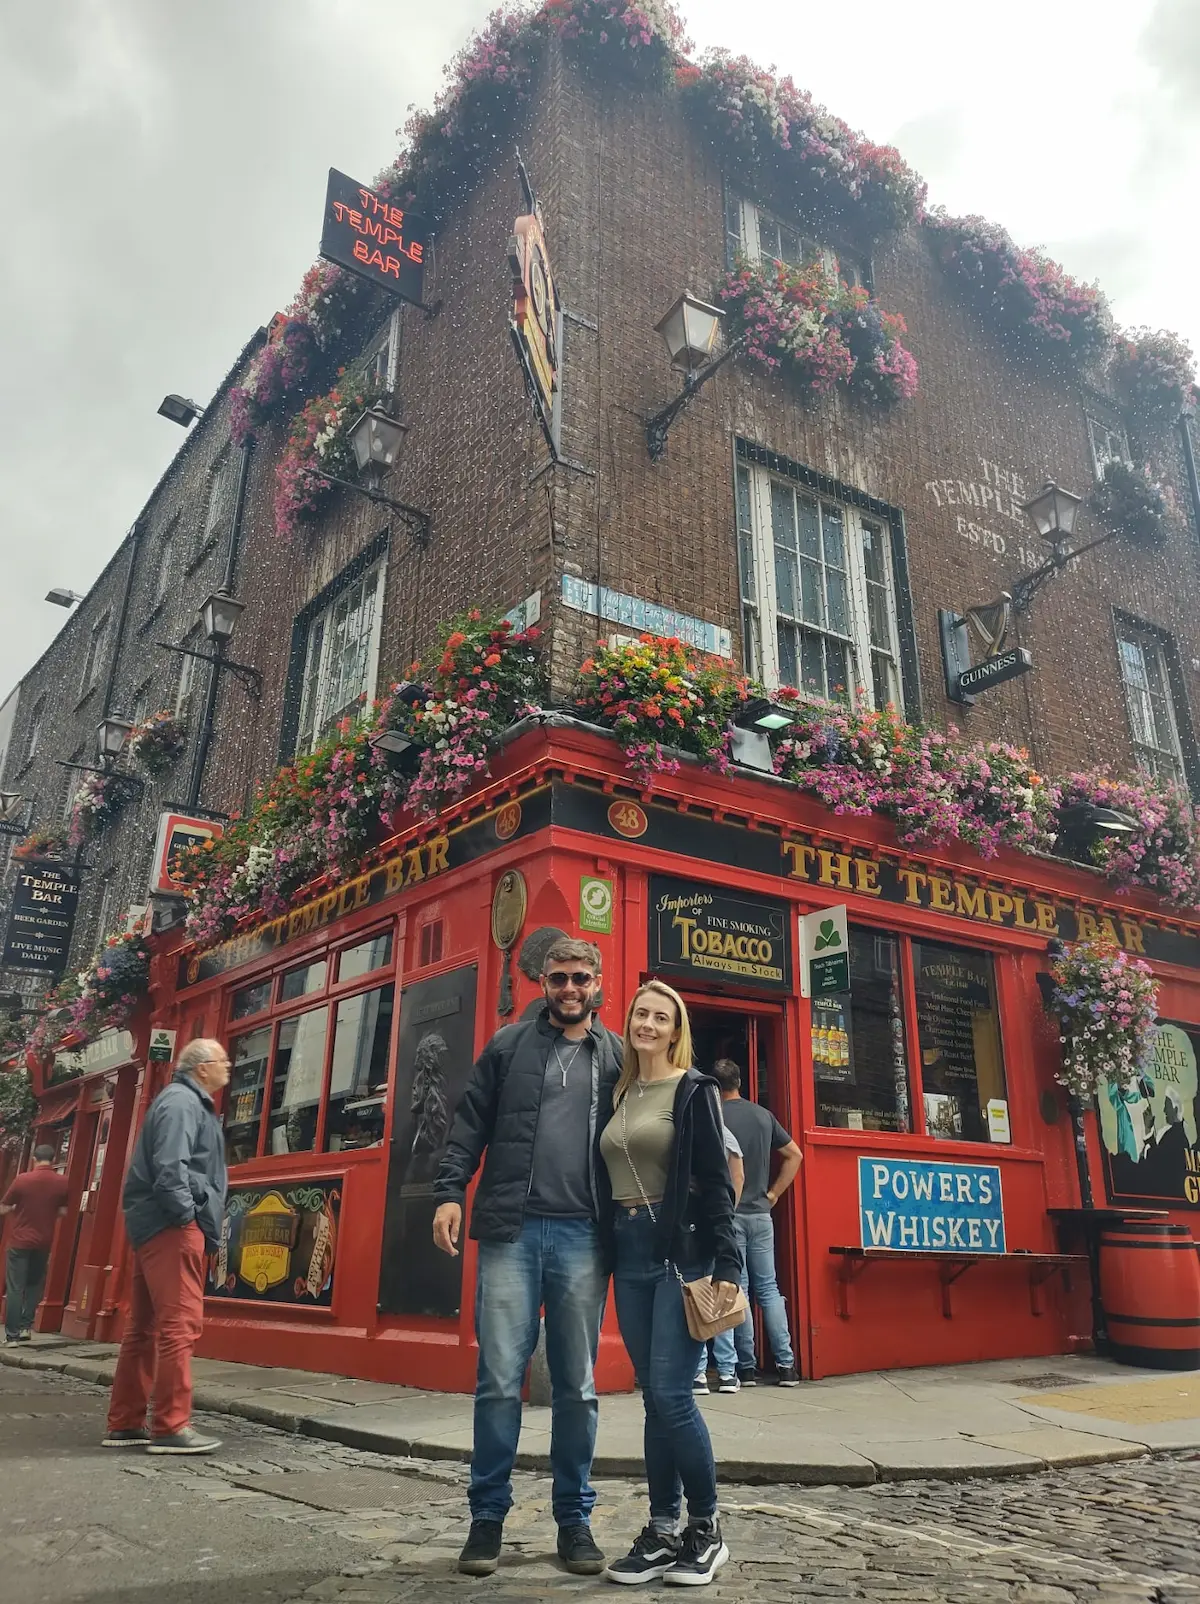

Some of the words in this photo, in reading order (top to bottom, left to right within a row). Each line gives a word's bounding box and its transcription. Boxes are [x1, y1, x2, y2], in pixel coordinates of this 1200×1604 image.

[359, 188, 404, 229] THE
[333, 201, 424, 264] TEMPLE
[353, 240, 401, 279] BAR
[978, 457, 1027, 499] THE
[925, 479, 1025, 527] TEMPLE
[957, 517, 1007, 554] ESTD
[960, 653, 1017, 688] GUINNESS
[613, 805, 641, 831] 48
[41, 870, 62, 881] THE
[384, 836, 452, 897] BAR
[20, 874, 79, 895] TEMPLE
[31, 889, 63, 905] BAR
[781, 840, 884, 897] THE
[897, 867, 1062, 935] TEMPLE
[1075, 910, 1147, 954] BAR
[271, 879, 374, 947] TEMPLE
[655, 892, 714, 917] Importers
[691, 907, 704, 917] OF
[14, 914, 36, 925] BEER
[36, 917, 70, 929] GARDEN
[706, 915, 729, 930] FINE
[729, 919, 772, 938] SMOKING
[11, 941, 33, 952] LIVE
[33, 944, 64, 955] MUSIC
[220, 924, 266, 968] THE
[672, 915, 774, 965] TOBACCO
[21, 951, 51, 963] DAILY
[692, 954, 734, 972] Always
[737, 961, 749, 974] in
[751, 963, 783, 980] Stock
[922, 964, 966, 978] TEMPLE
[967, 970, 989, 988] BAR
[1152, 1032, 1175, 1049] HE
[1154, 1063, 1181, 1084] BAR
[872, 1164, 993, 1205] POWER'S
[865, 1210, 1002, 1249] WHISKEY
